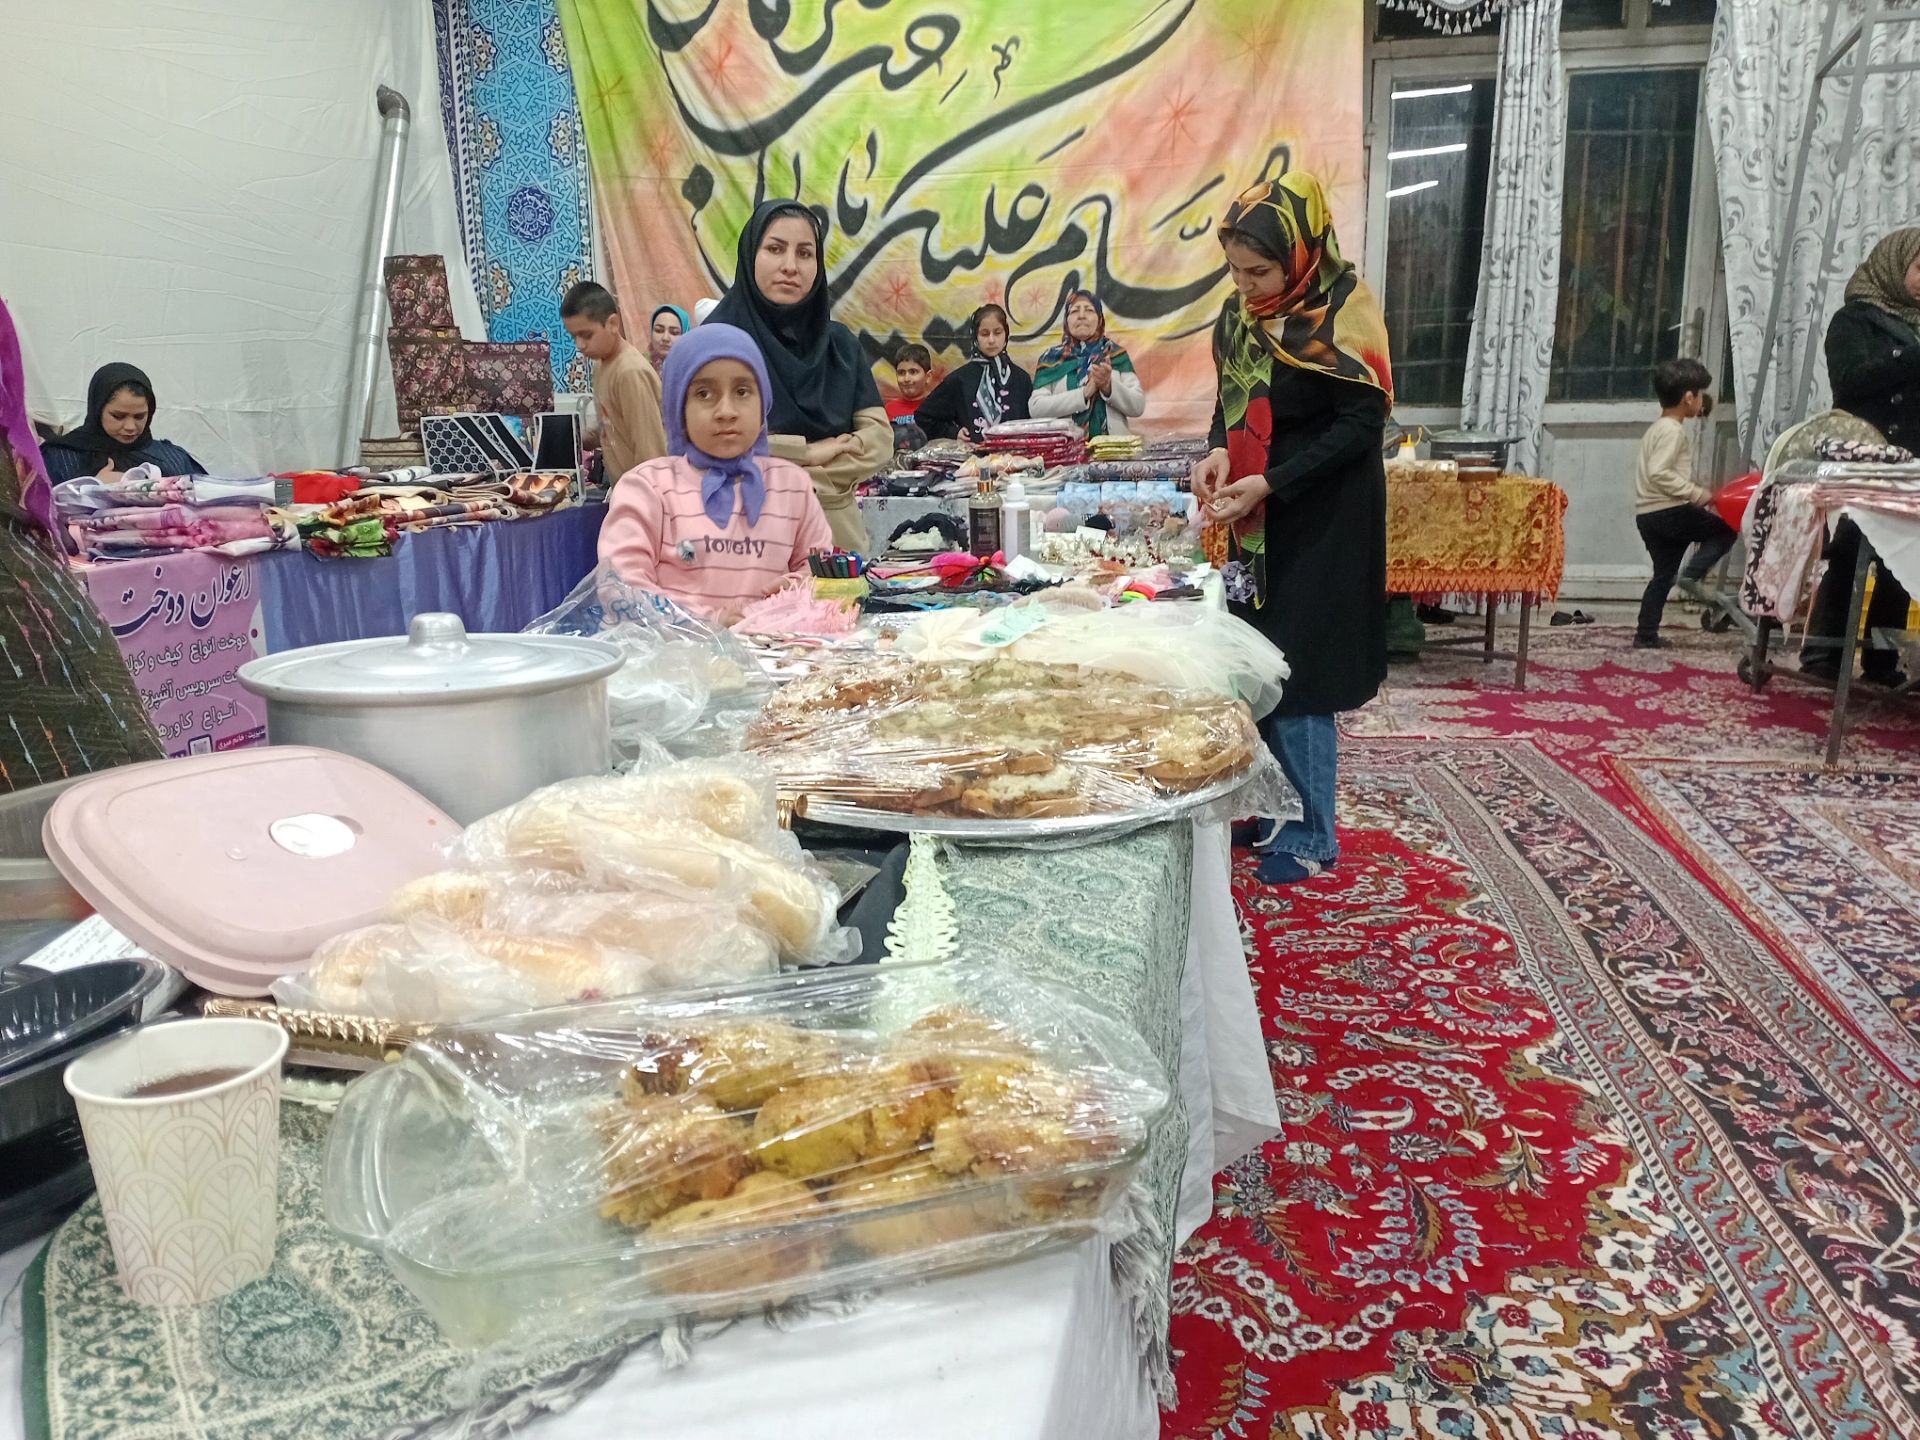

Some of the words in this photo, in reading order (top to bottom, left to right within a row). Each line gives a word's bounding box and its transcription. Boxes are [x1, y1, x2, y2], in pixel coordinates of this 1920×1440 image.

[703, 534, 765, 558] lovely
[110, 566, 184, 637] دوخت
[190, 637, 216, 663] انواع
[217, 632, 248, 651] دوخت
[126, 651, 145, 675] کول
[148, 656, 155, 672] و
[157, 643, 182, 667] کیف
[176, 676, 221, 701] سرویس
[202, 700, 238, 730] انواع
